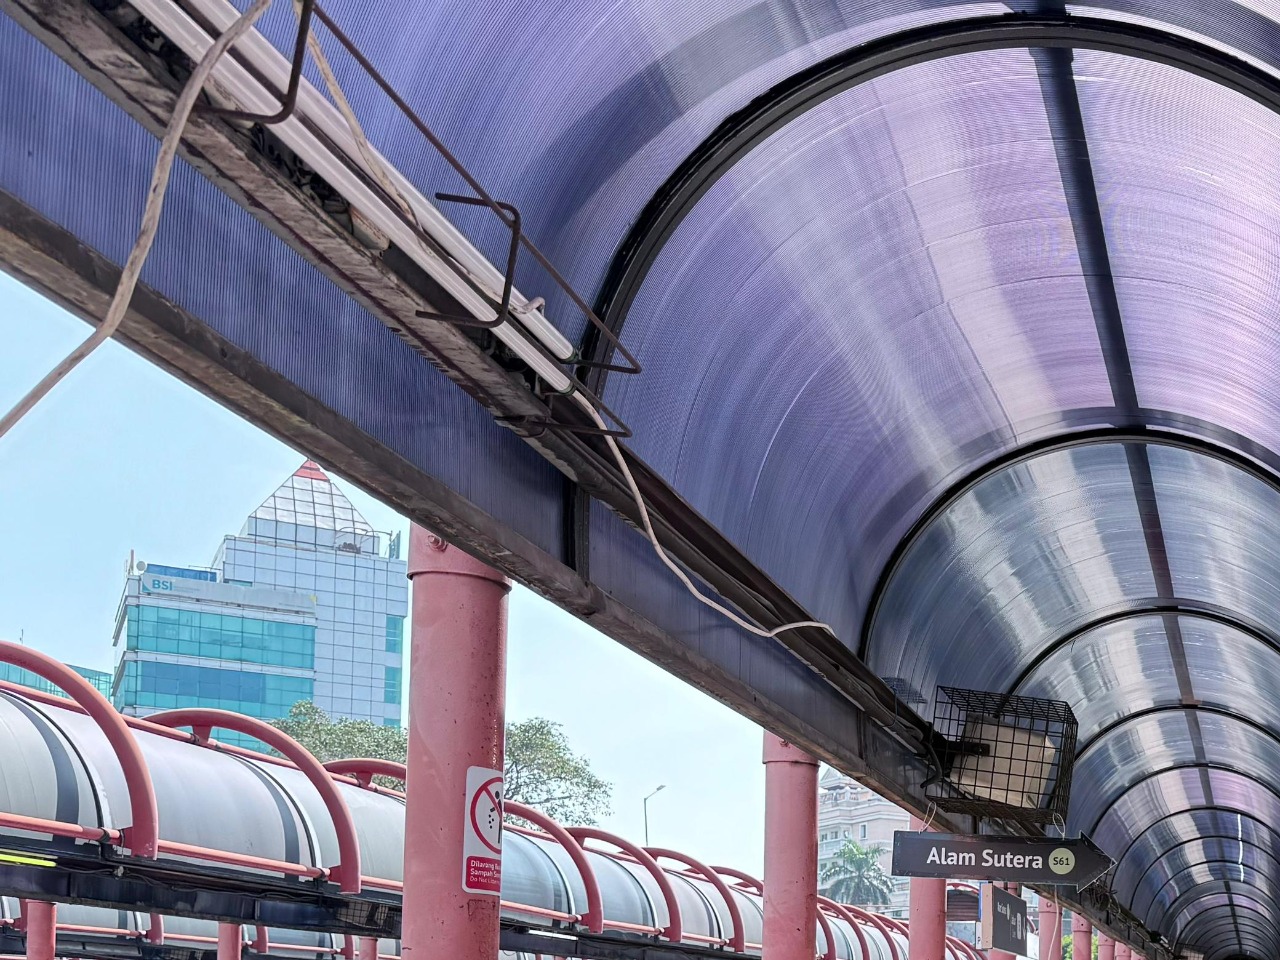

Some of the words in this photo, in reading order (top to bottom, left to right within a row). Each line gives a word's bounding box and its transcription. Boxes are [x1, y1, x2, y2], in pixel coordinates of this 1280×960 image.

[152, 579, 173, 591] BSI
[926, 847, 976, 866] Alam
[981, 849, 1043, 869] Sutera
[1052, 856, 1070, 866] S61
[470, 860, 495, 870] Dilarang
[470, 868, 494, 877] Sampah
